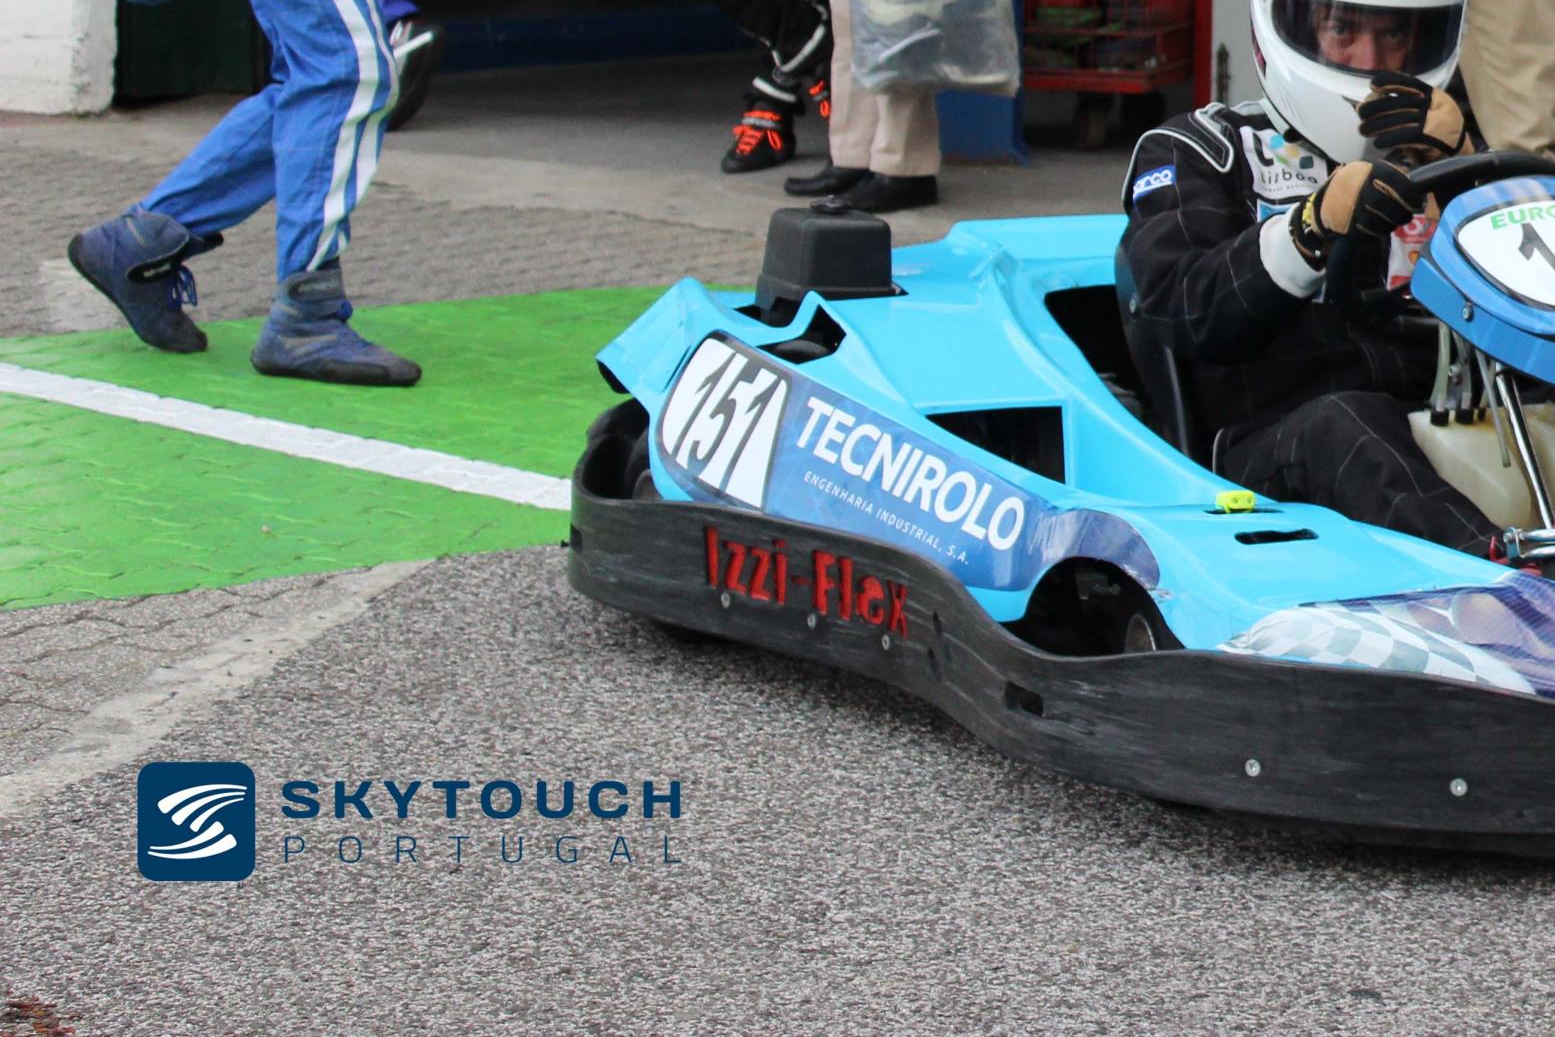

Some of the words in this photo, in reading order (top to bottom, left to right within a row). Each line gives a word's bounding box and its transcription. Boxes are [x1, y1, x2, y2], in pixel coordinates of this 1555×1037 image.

[674, 350, 783, 494] 151
[797, 396, 1026, 552] TECNIROLO
[803, 470, 873, 515] ENGENHARIA
[875, 507, 943, 553] INDUSTRIAL,
[946, 544, 969, 565] S.A.
